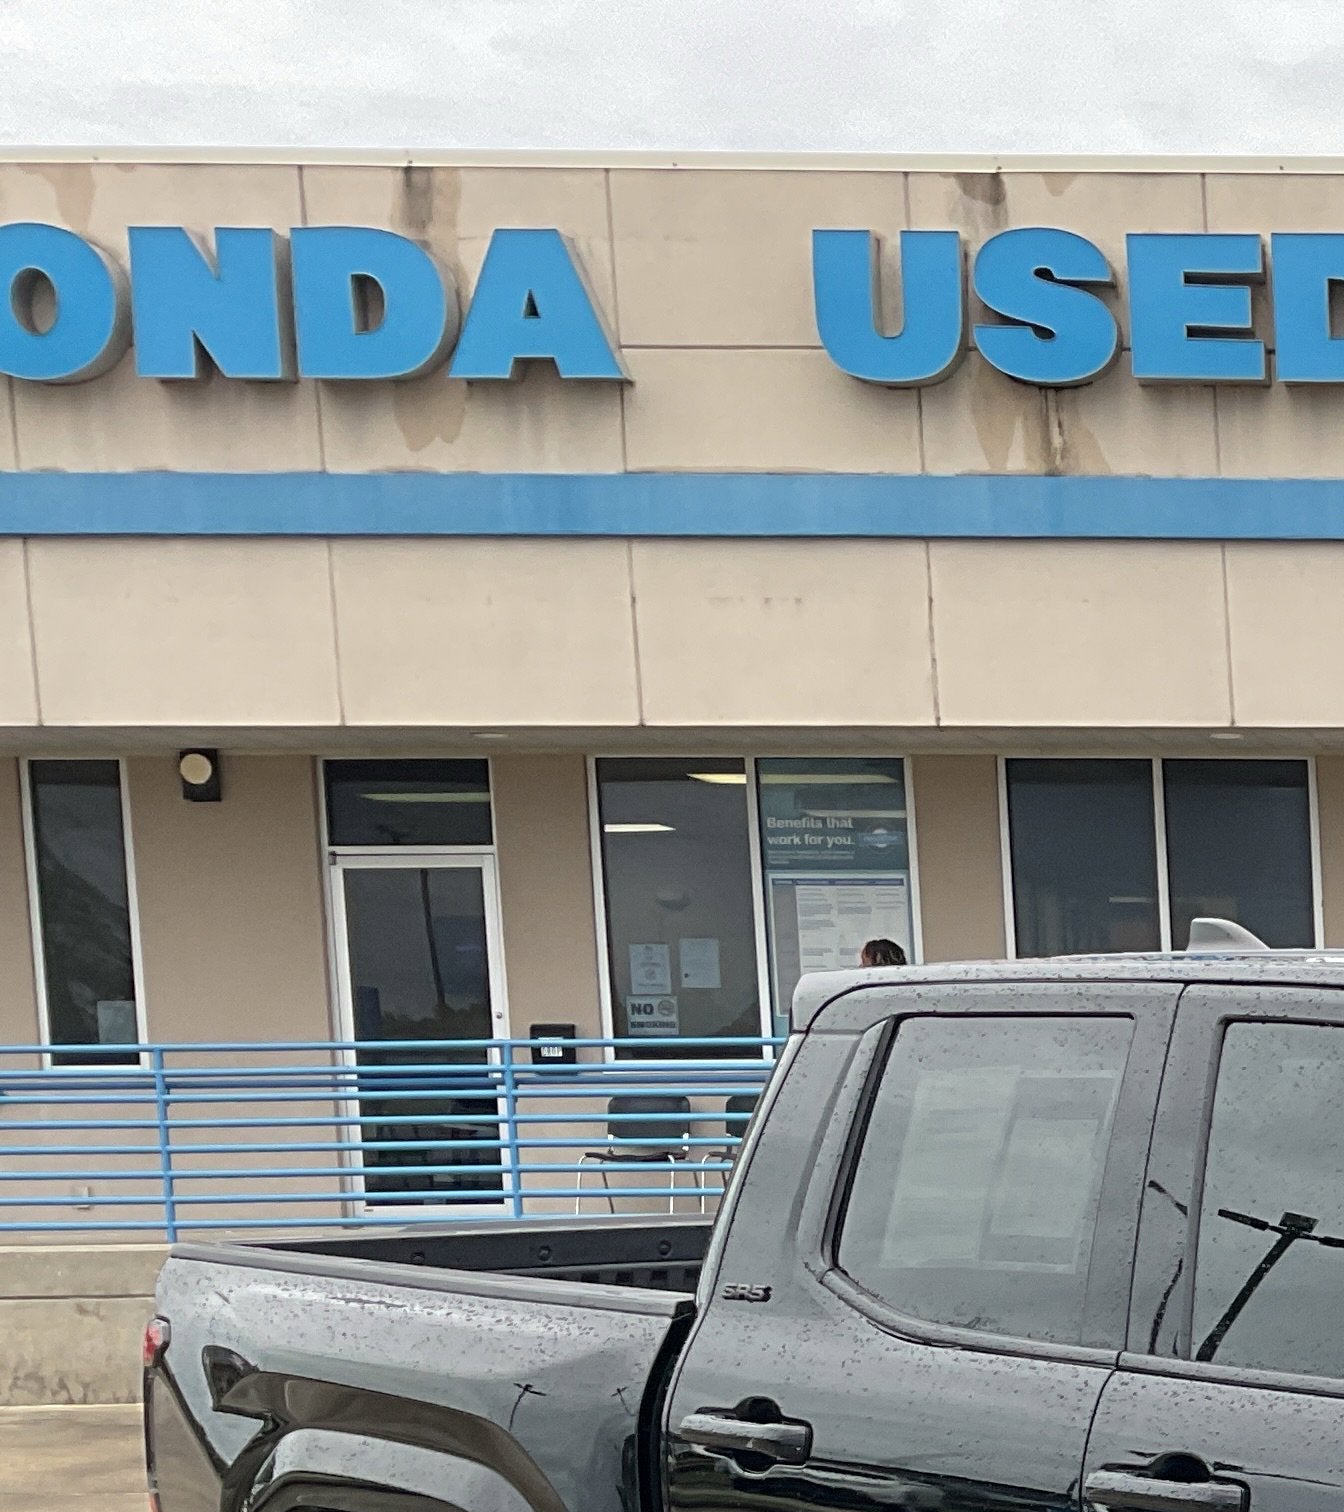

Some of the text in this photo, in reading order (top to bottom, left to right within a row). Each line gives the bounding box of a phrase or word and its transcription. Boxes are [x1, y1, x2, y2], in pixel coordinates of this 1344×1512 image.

[0, 222, 631, 384] ONDA
[767, 817, 854, 828] Benefits that
[767, 834, 802, 845] work
[805, 834, 823, 845] for
[826, 835, 855, 848] you.
[631, 1003, 654, 1016] NO
[631, 1021, 676, 1029] SMOKING
[722, 1283, 771, 1302] SR5
